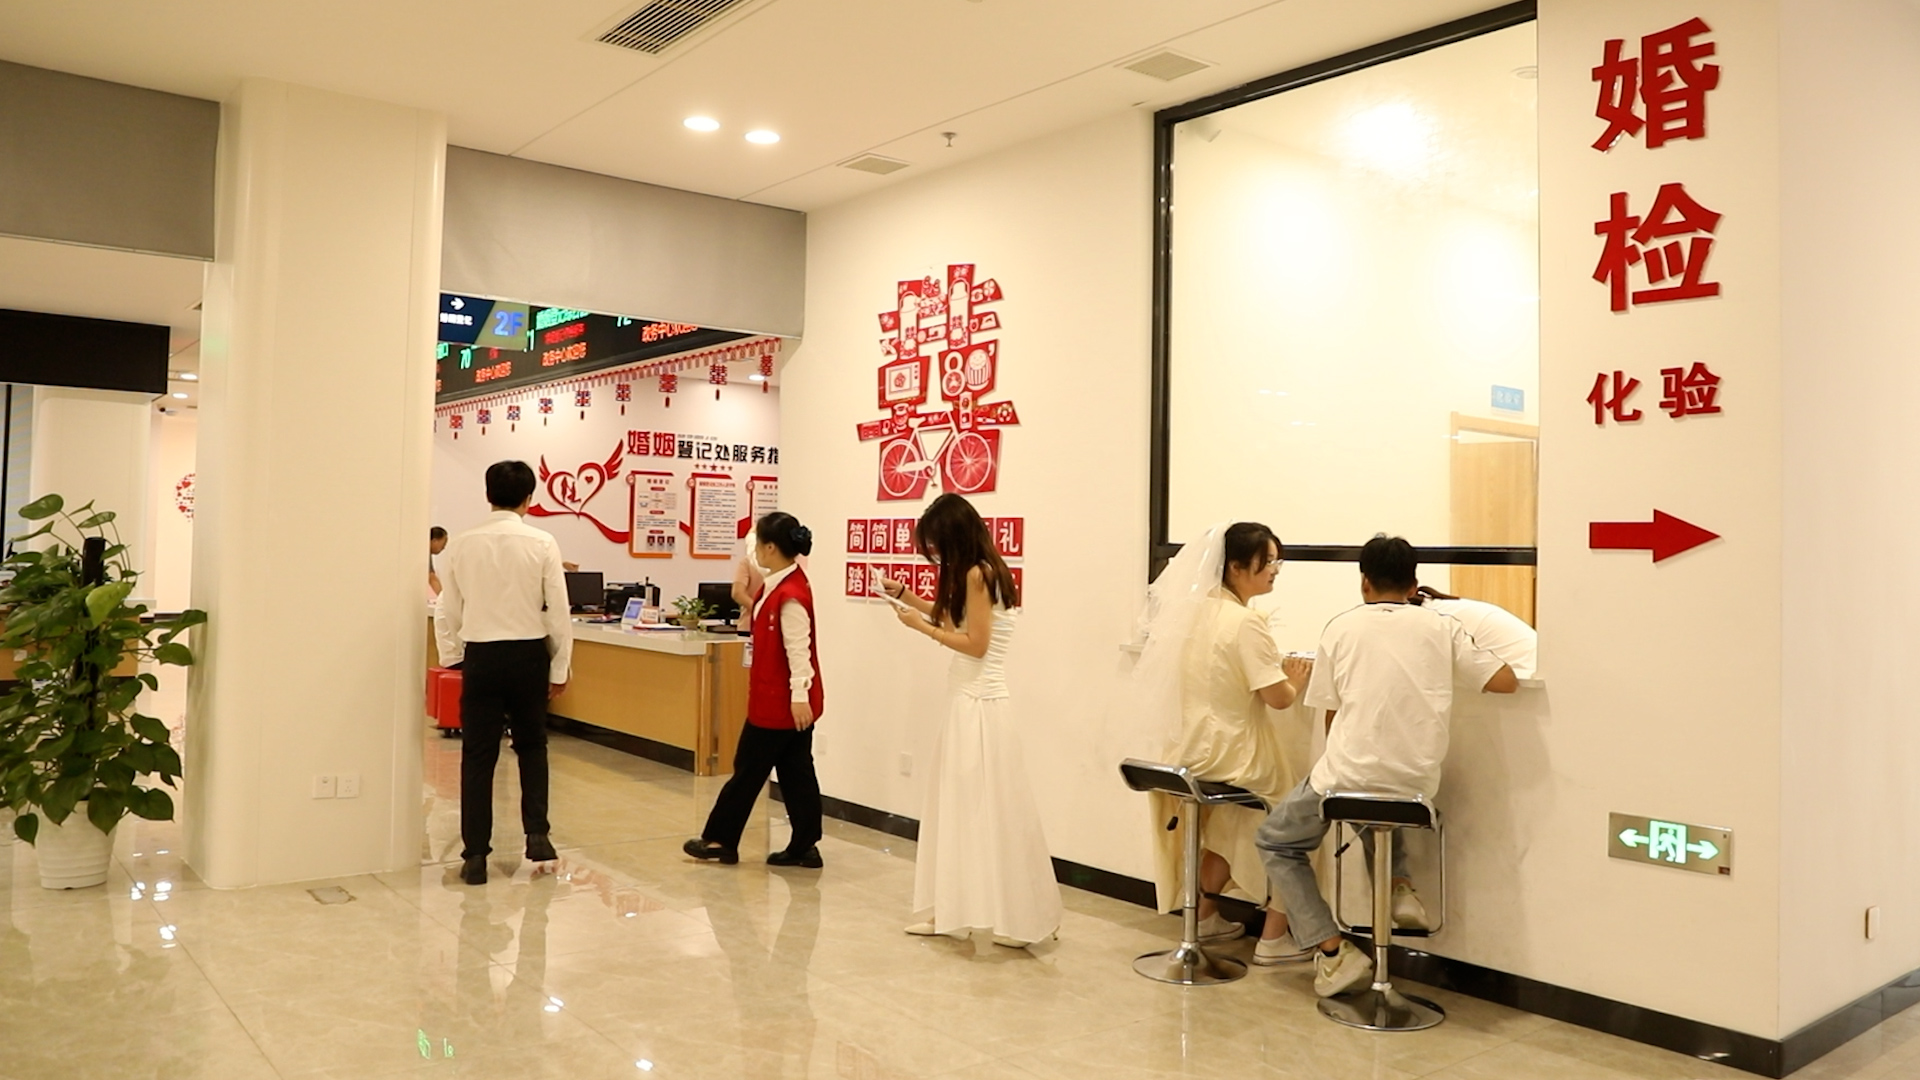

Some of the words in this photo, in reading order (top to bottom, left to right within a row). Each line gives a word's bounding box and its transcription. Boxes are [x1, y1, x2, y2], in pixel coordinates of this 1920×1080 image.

[1592, 17, 1721, 312] 婚检
[493, 311, 524, 337] 2F
[1587, 362, 1722, 425] 化验
